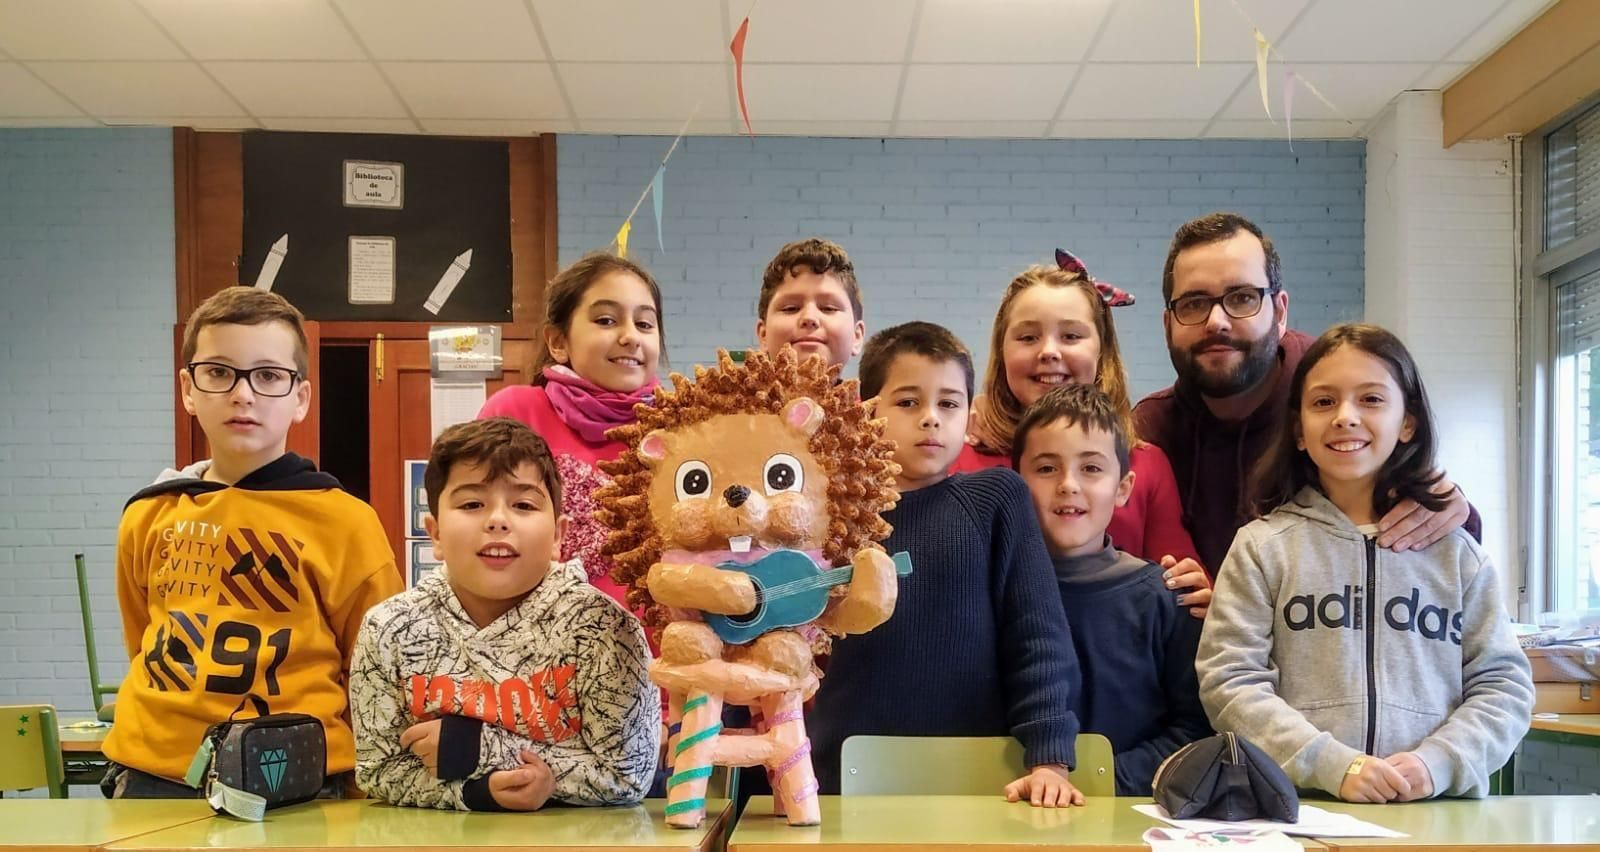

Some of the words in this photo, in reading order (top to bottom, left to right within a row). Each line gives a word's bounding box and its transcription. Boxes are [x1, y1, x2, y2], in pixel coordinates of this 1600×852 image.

[355, 172, 393, 181] Biblioteca
[162, 520, 222, 542] GVITY
[159, 538, 219, 560] GVITY
[1283, 584, 1463, 646] adidas
[204, 620, 292, 696] 91
